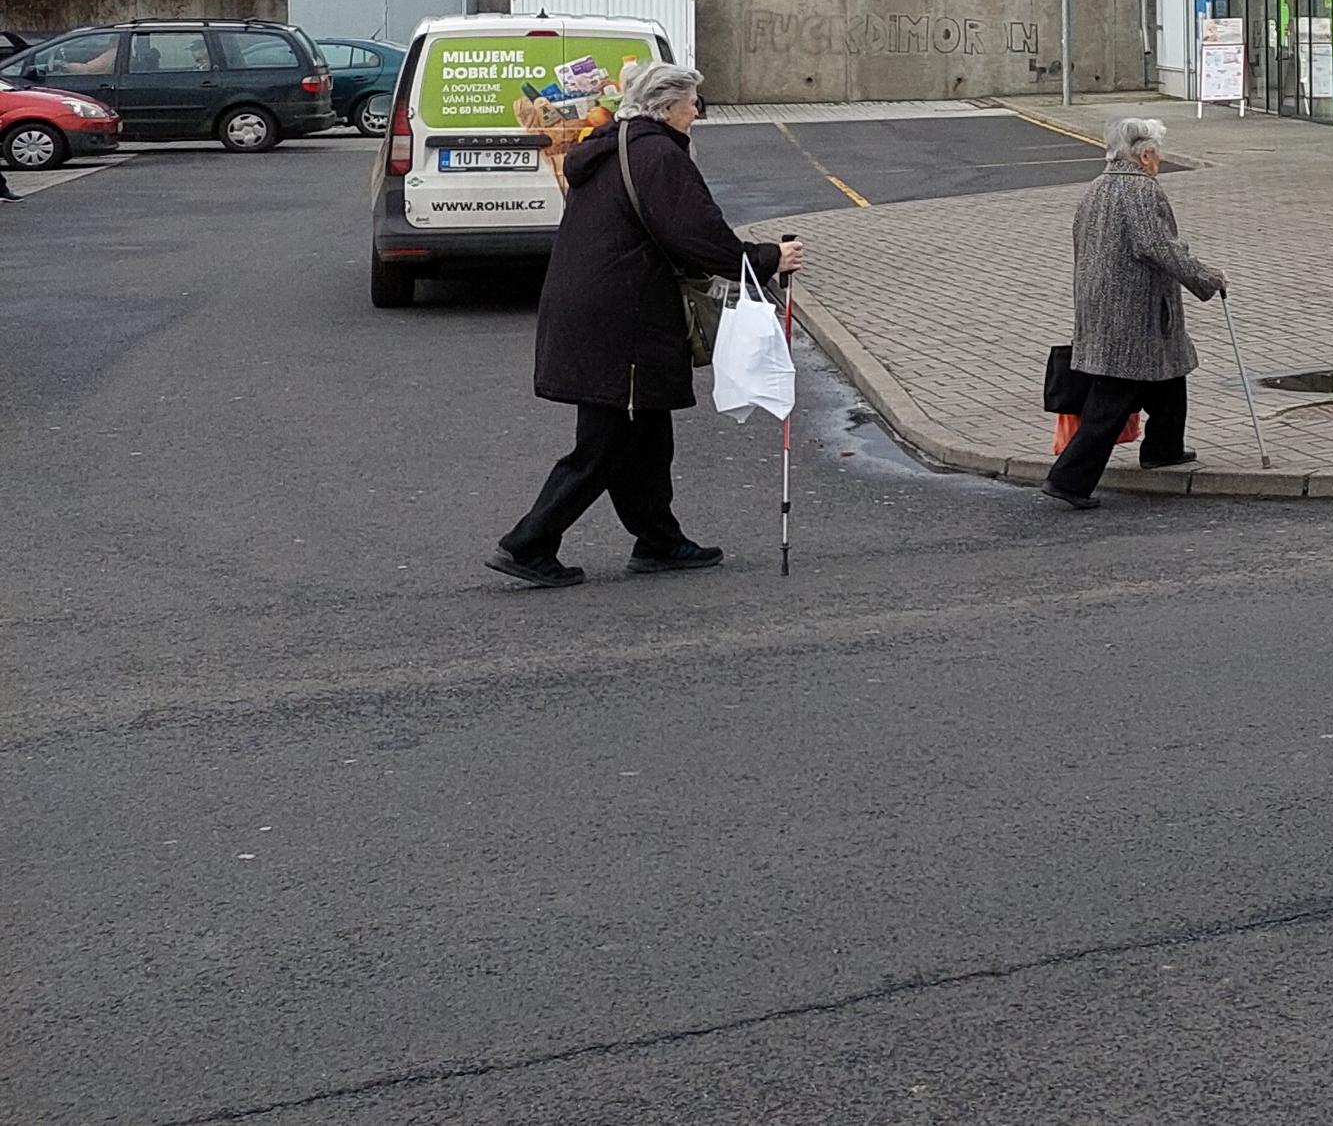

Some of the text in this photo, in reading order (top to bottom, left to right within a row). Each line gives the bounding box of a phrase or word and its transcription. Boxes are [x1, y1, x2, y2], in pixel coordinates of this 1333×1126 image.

[443, 51, 524, 63] MILUJEME
[443, 64, 546, 79] DOBRÉ JÍDLO
[443, 84, 501, 92] A DOVEZEME
[443, 93, 497, 103] VÁM HO UŽ
[443, 105, 505, 115] DO 60 MINUT
[455, 152, 482, 165] 1UT
[493, 152, 530, 165] 8278
[432, 200, 545, 212] WWW.ROHLIK.CZ
